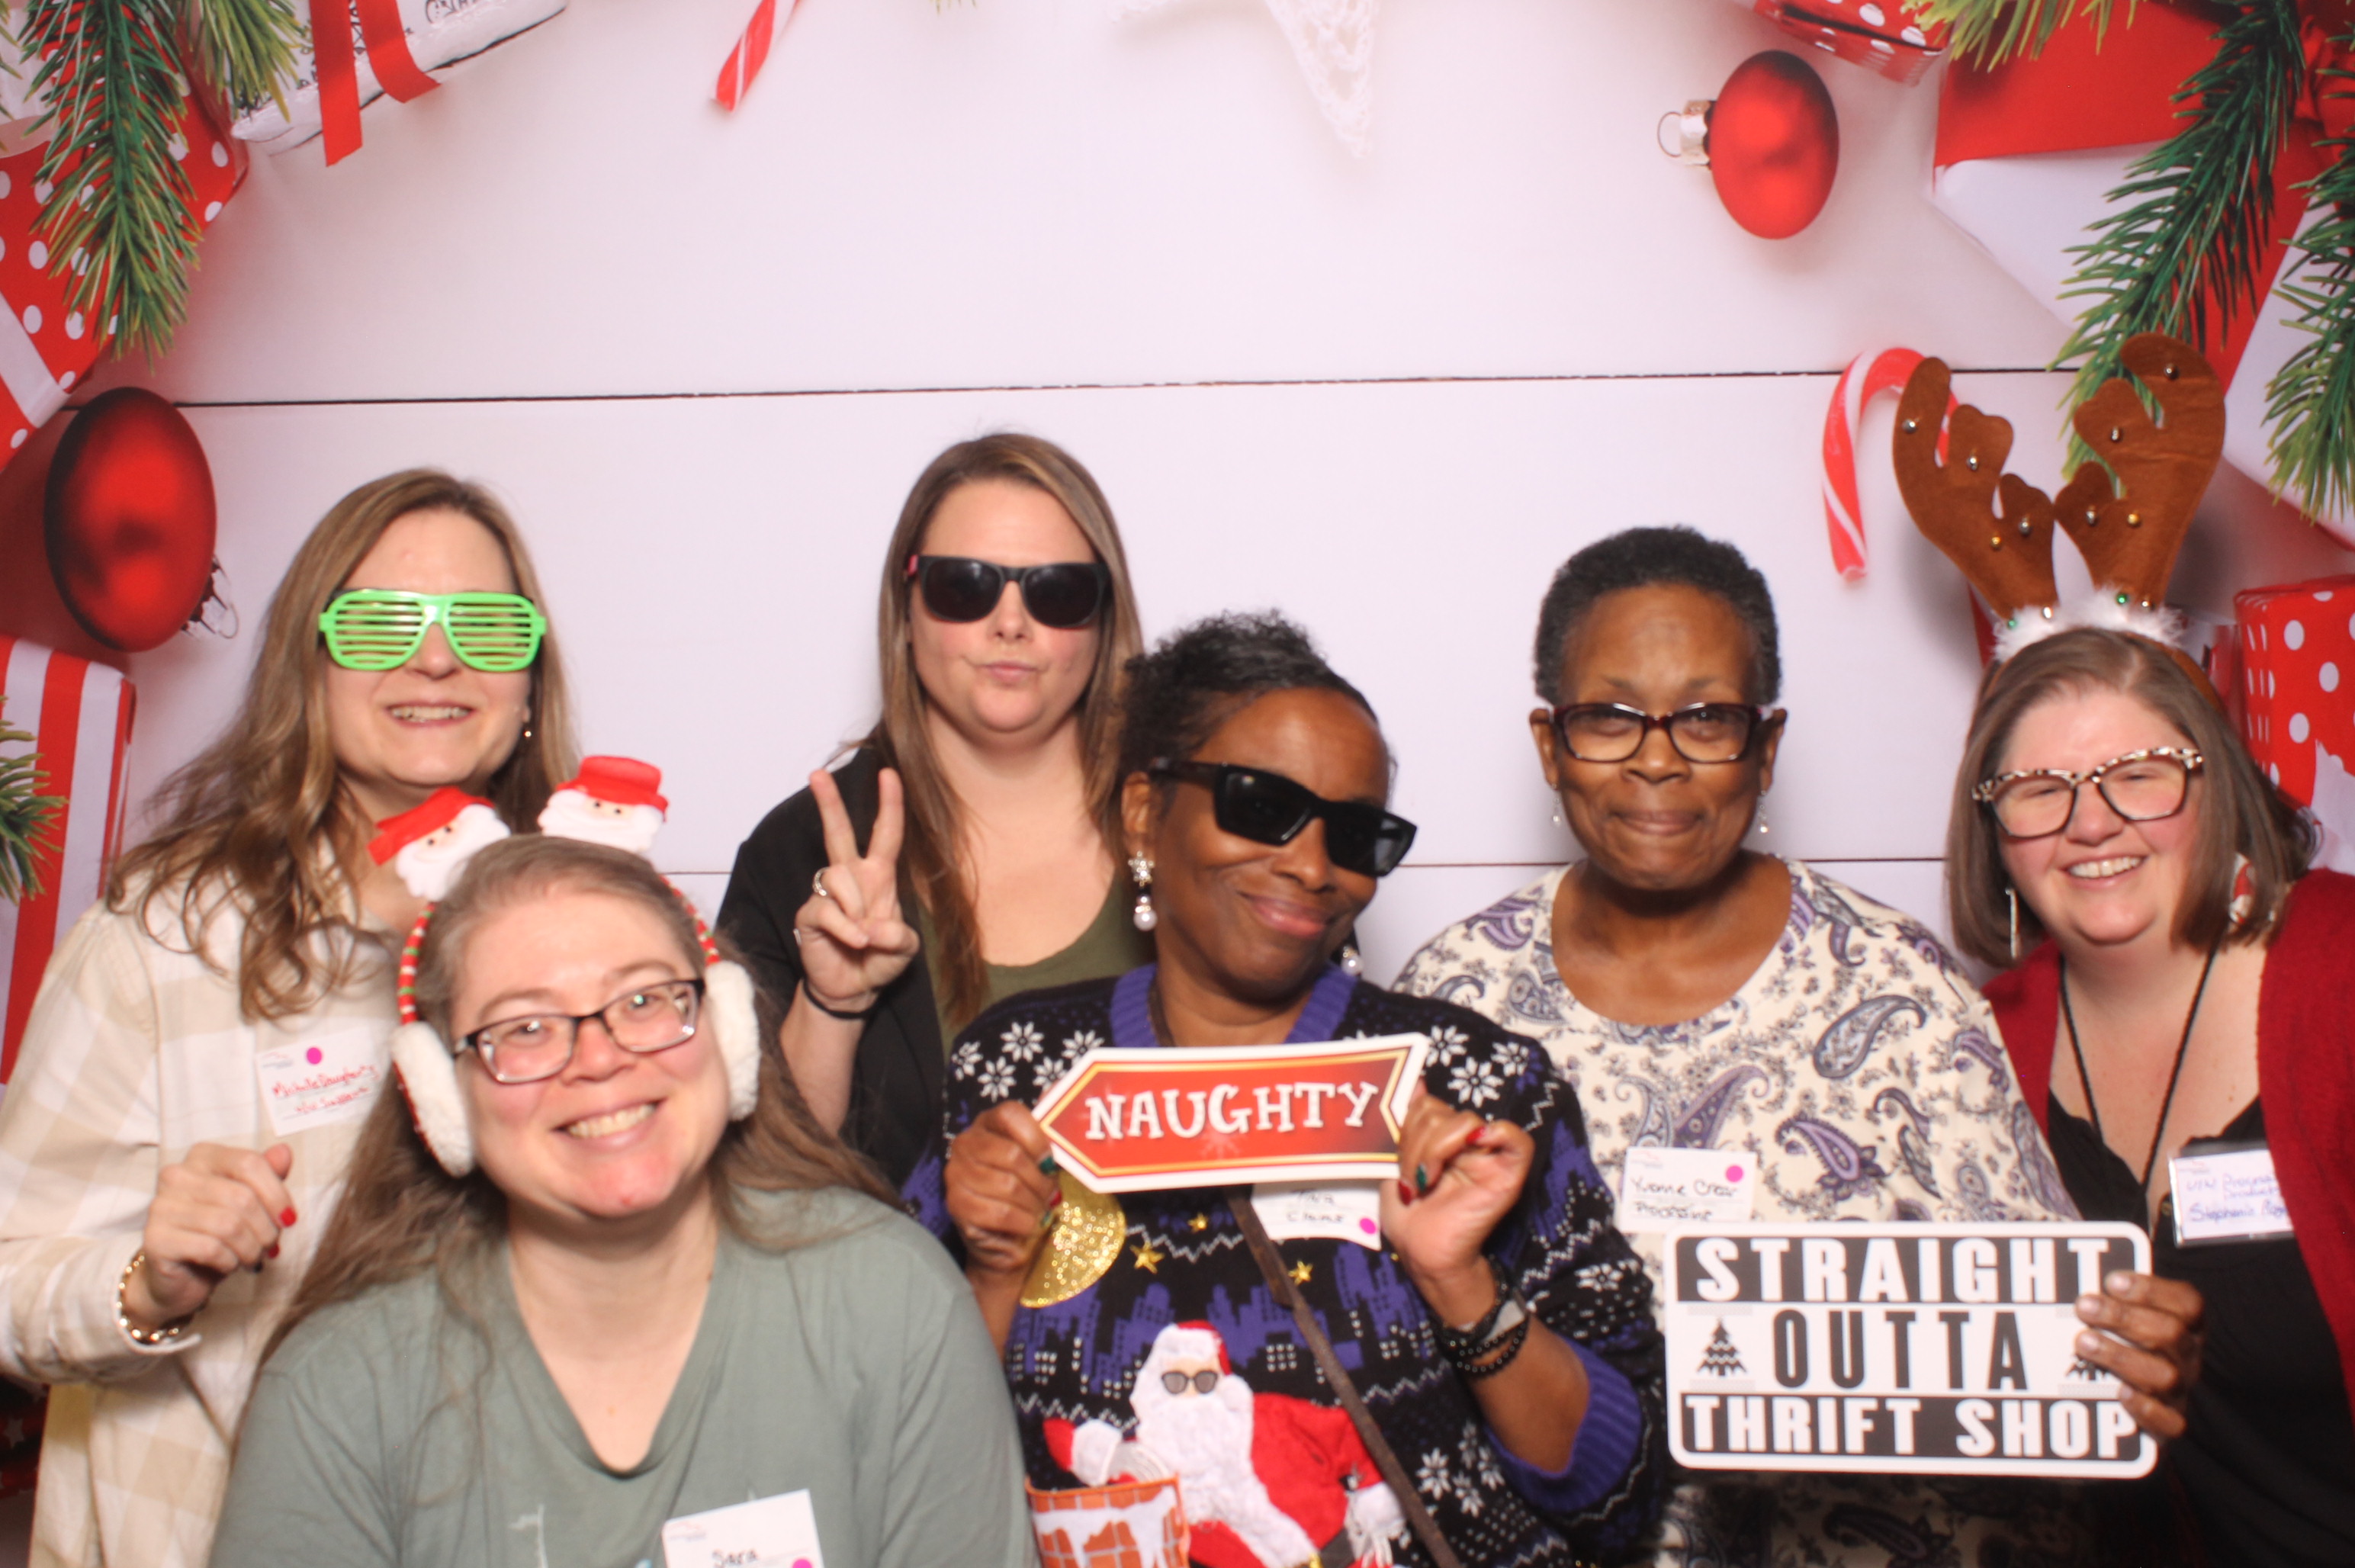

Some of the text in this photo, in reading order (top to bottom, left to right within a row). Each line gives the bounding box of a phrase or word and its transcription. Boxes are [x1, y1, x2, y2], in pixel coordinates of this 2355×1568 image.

[1084, 1081, 1379, 1141] NAUGHTY
[1630, 1174, 1686, 1197] Yvonne
[1695, 1237, 2109, 1302] STRAIGHT
[1772, 1309, 2029, 1390] OUTTA
[1685, 1395, 2137, 1460] THRIFT SHOP
